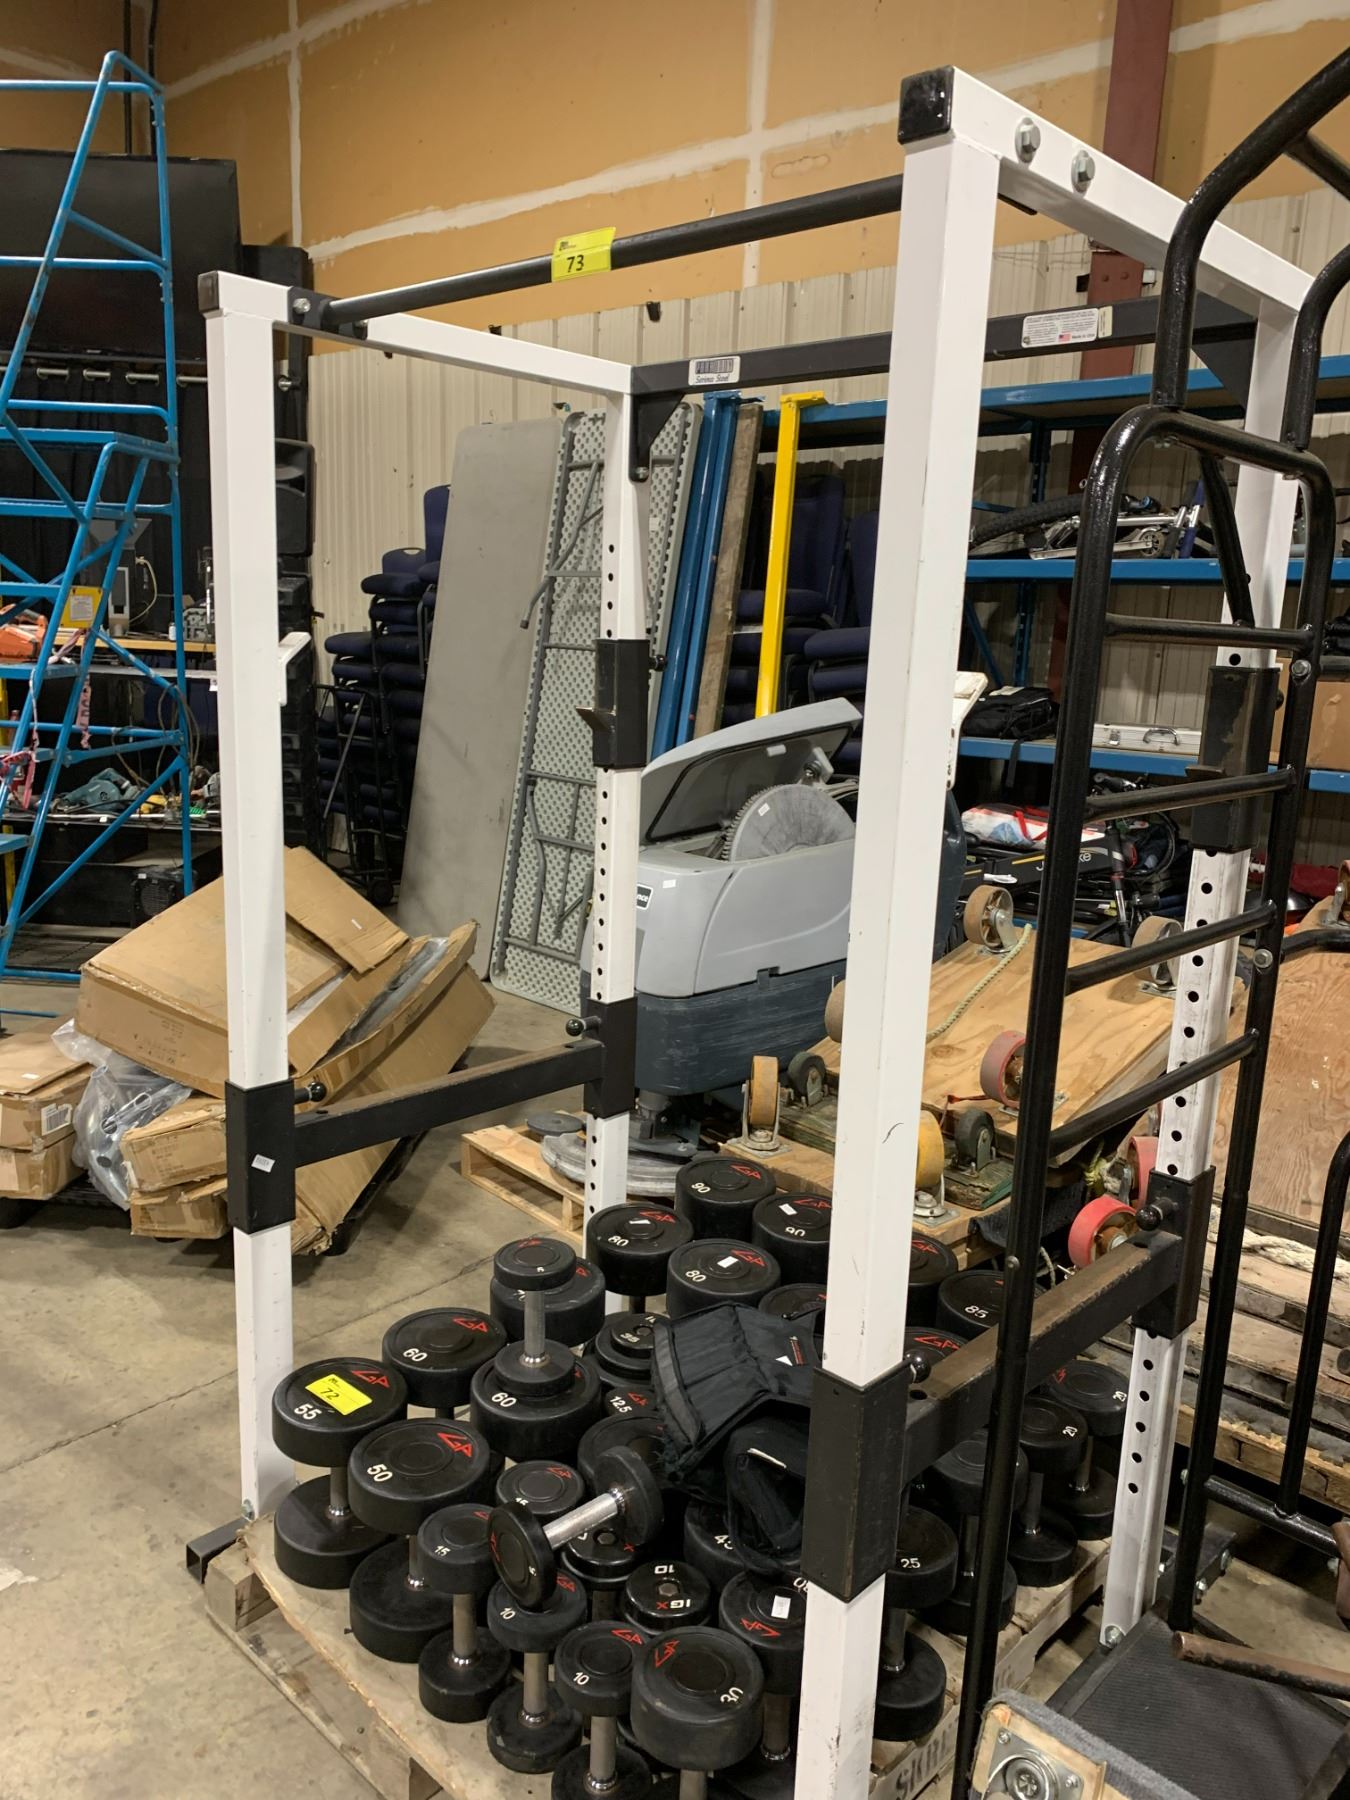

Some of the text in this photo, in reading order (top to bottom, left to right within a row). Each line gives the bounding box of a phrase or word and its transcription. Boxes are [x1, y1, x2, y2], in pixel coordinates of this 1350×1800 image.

[566, 254, 585, 273] 73
[691, 1183, 711, 1194] 90
[607, 1236, 629, 1247] 80
[685, 1270, 707, 1283] 80
[964, 1306, 989, 1319] 85
[403, 1348, 428, 1362] 60
[320, 1387, 340, 1401] 72
[491, 1392, 517, 1408] 60
[1113, 1390, 1128, 1402] 20
[609, 1396, 633, 1413] 12.5
[294, 1404, 322, 1421] 55
[1062, 1425, 1078, 1437] 20
[366, 1464, 394, 1483] 50
[435, 1544, 451, 1558] 15
[654, 1564, 675, 1575] 10
[900, 1557, 921, 1570] 25
[499, 1607, 516, 1620] 10
[573, 1671, 590, 1686] 10
